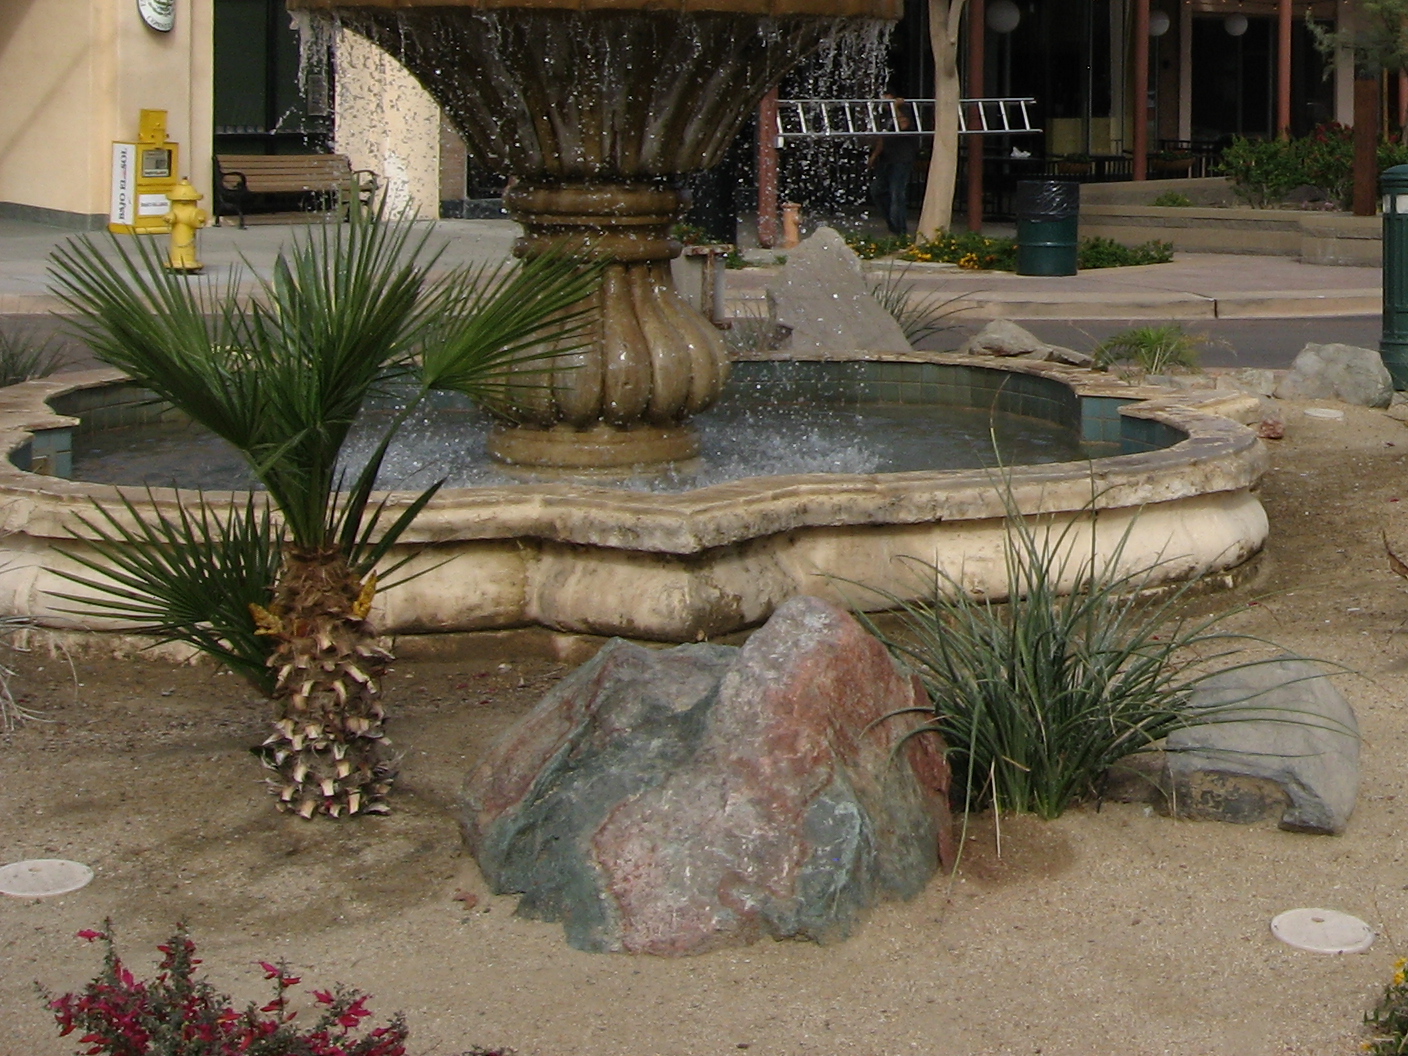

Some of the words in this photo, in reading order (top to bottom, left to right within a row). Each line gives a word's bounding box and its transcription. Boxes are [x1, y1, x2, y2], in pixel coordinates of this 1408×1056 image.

[120, 148, 128, 169] SOL
[119, 179, 126, 190] EL
[118, 192, 127, 220] BAJO
